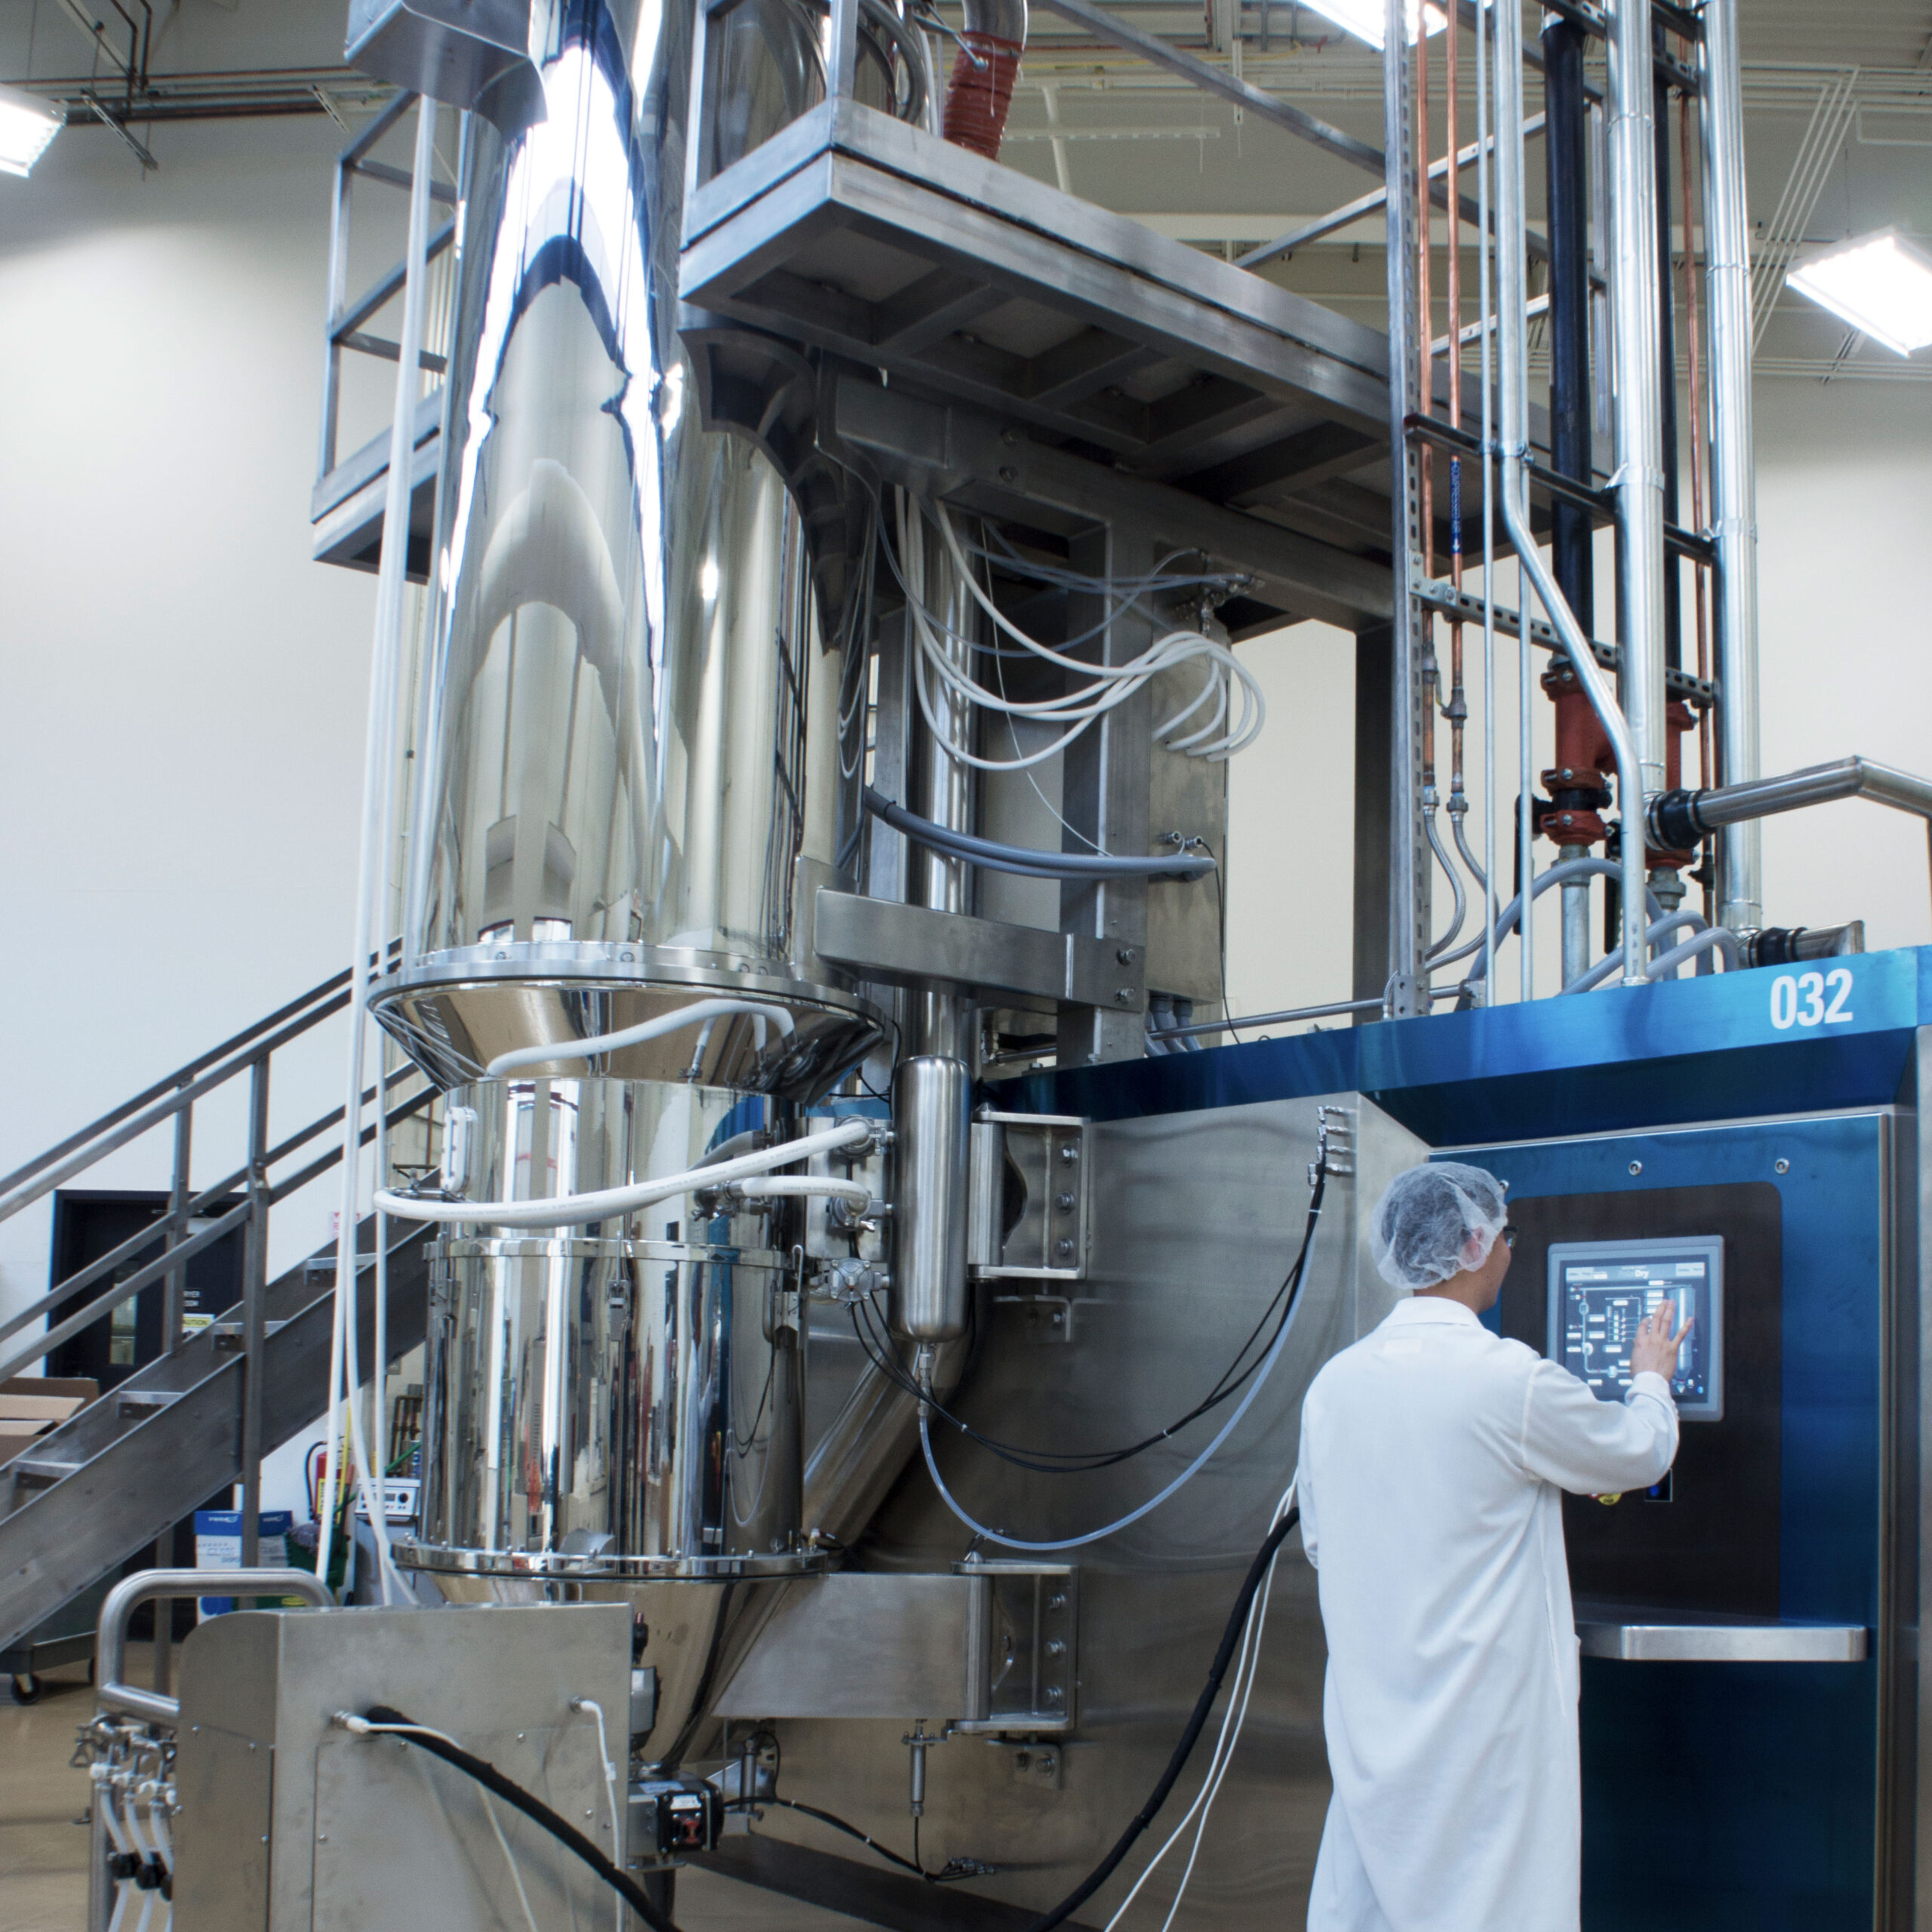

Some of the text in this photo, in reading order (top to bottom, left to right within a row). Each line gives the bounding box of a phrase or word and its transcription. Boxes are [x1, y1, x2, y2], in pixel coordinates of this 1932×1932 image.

[1451, 466, 1460, 533] COMPRESSED AIR
[1770, 968, 1854, 1030] 032
